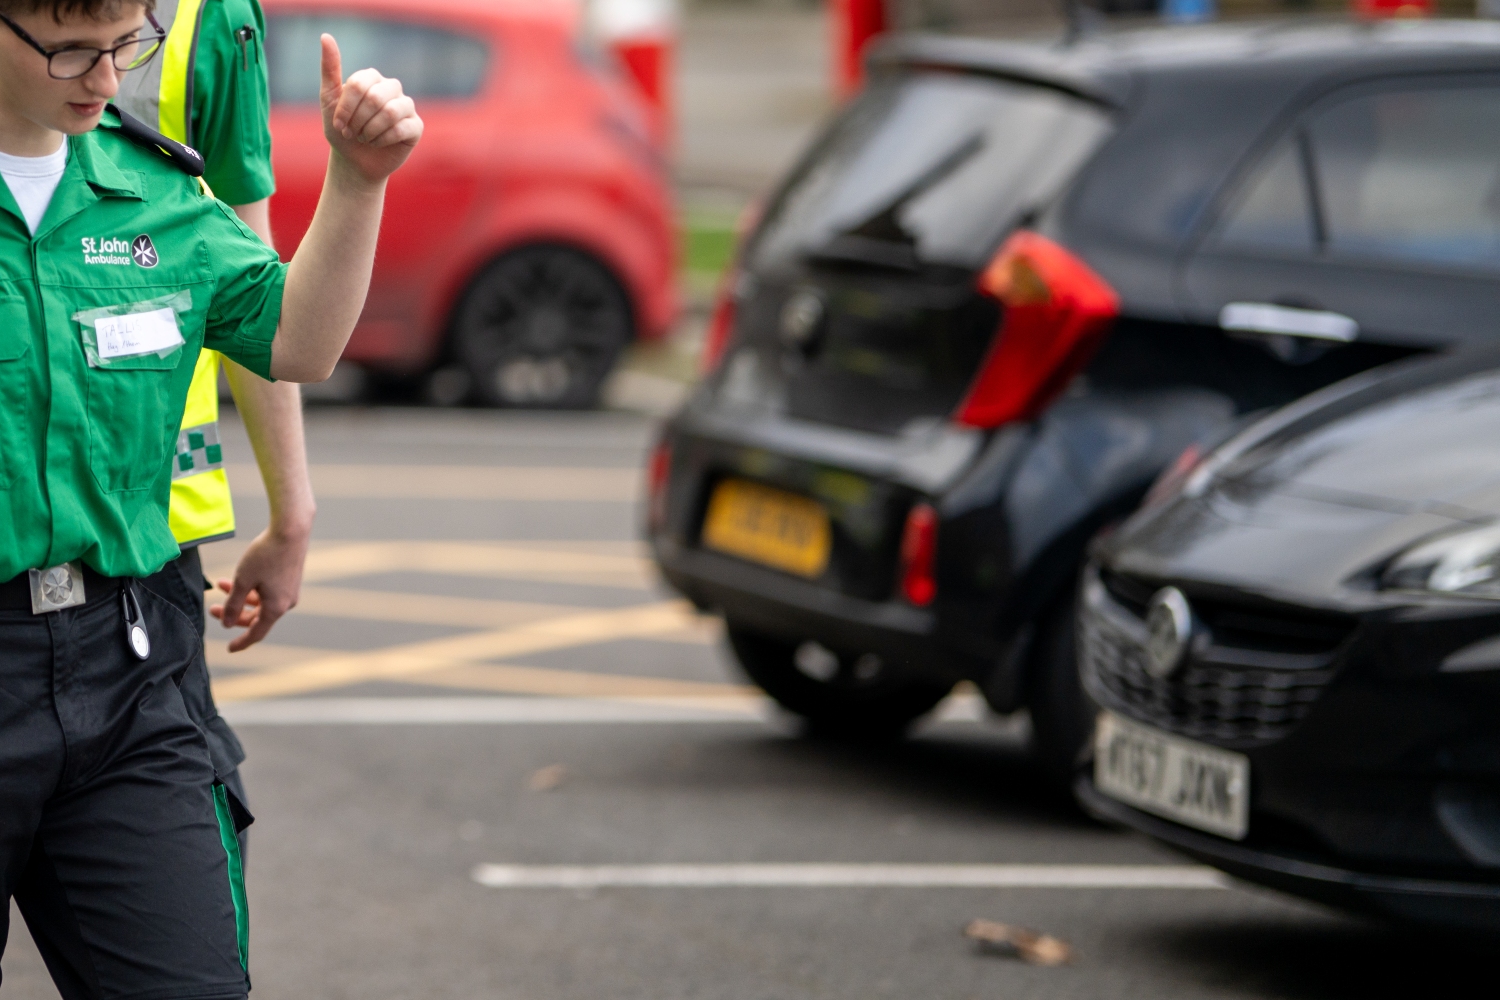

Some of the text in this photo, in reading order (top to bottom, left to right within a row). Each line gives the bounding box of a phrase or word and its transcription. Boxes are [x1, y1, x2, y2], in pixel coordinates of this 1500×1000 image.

[81, 237, 129, 254] St John
[85, 254, 130, 265] Ambulance
